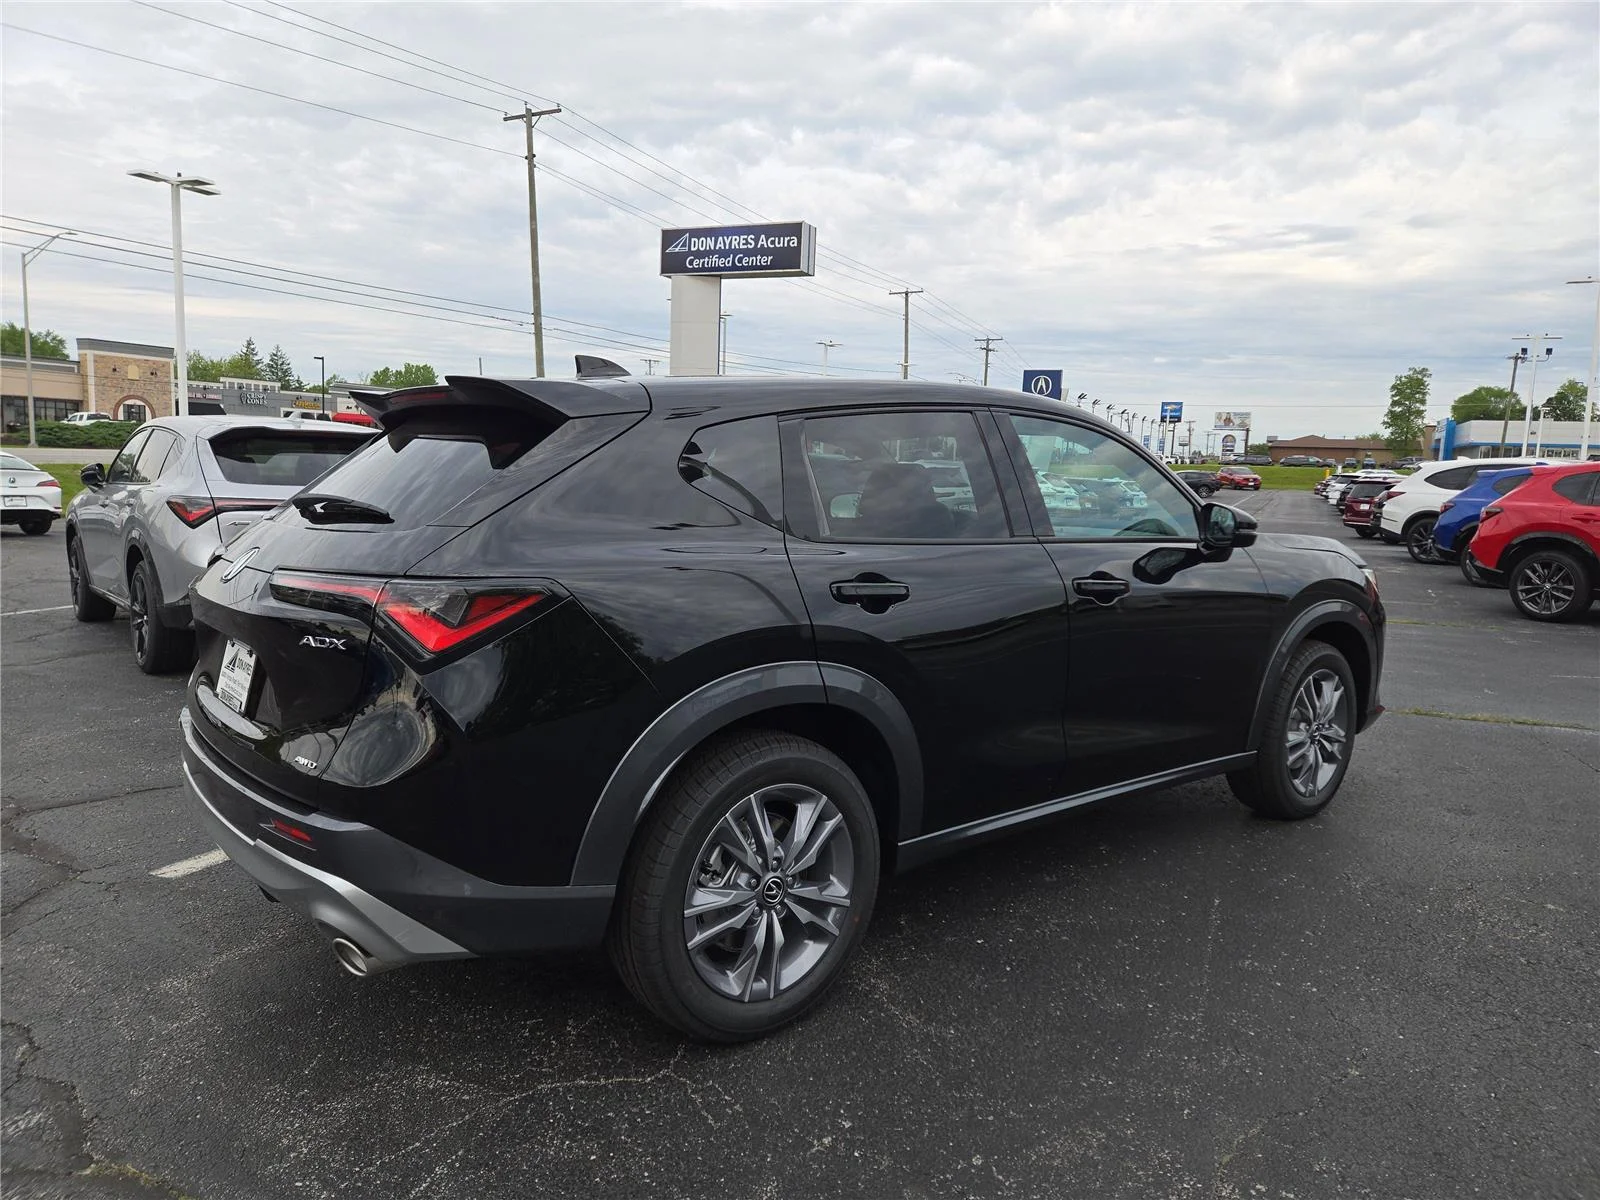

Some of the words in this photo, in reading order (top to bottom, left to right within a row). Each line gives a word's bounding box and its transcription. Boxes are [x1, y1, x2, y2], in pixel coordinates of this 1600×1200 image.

[757, 234, 798, 249] Acura
[686, 254, 733, 268] Certified
[735, 253, 773, 267] Center
[299, 635, 347, 650] ADX
[294, 755, 318, 769] AWD
